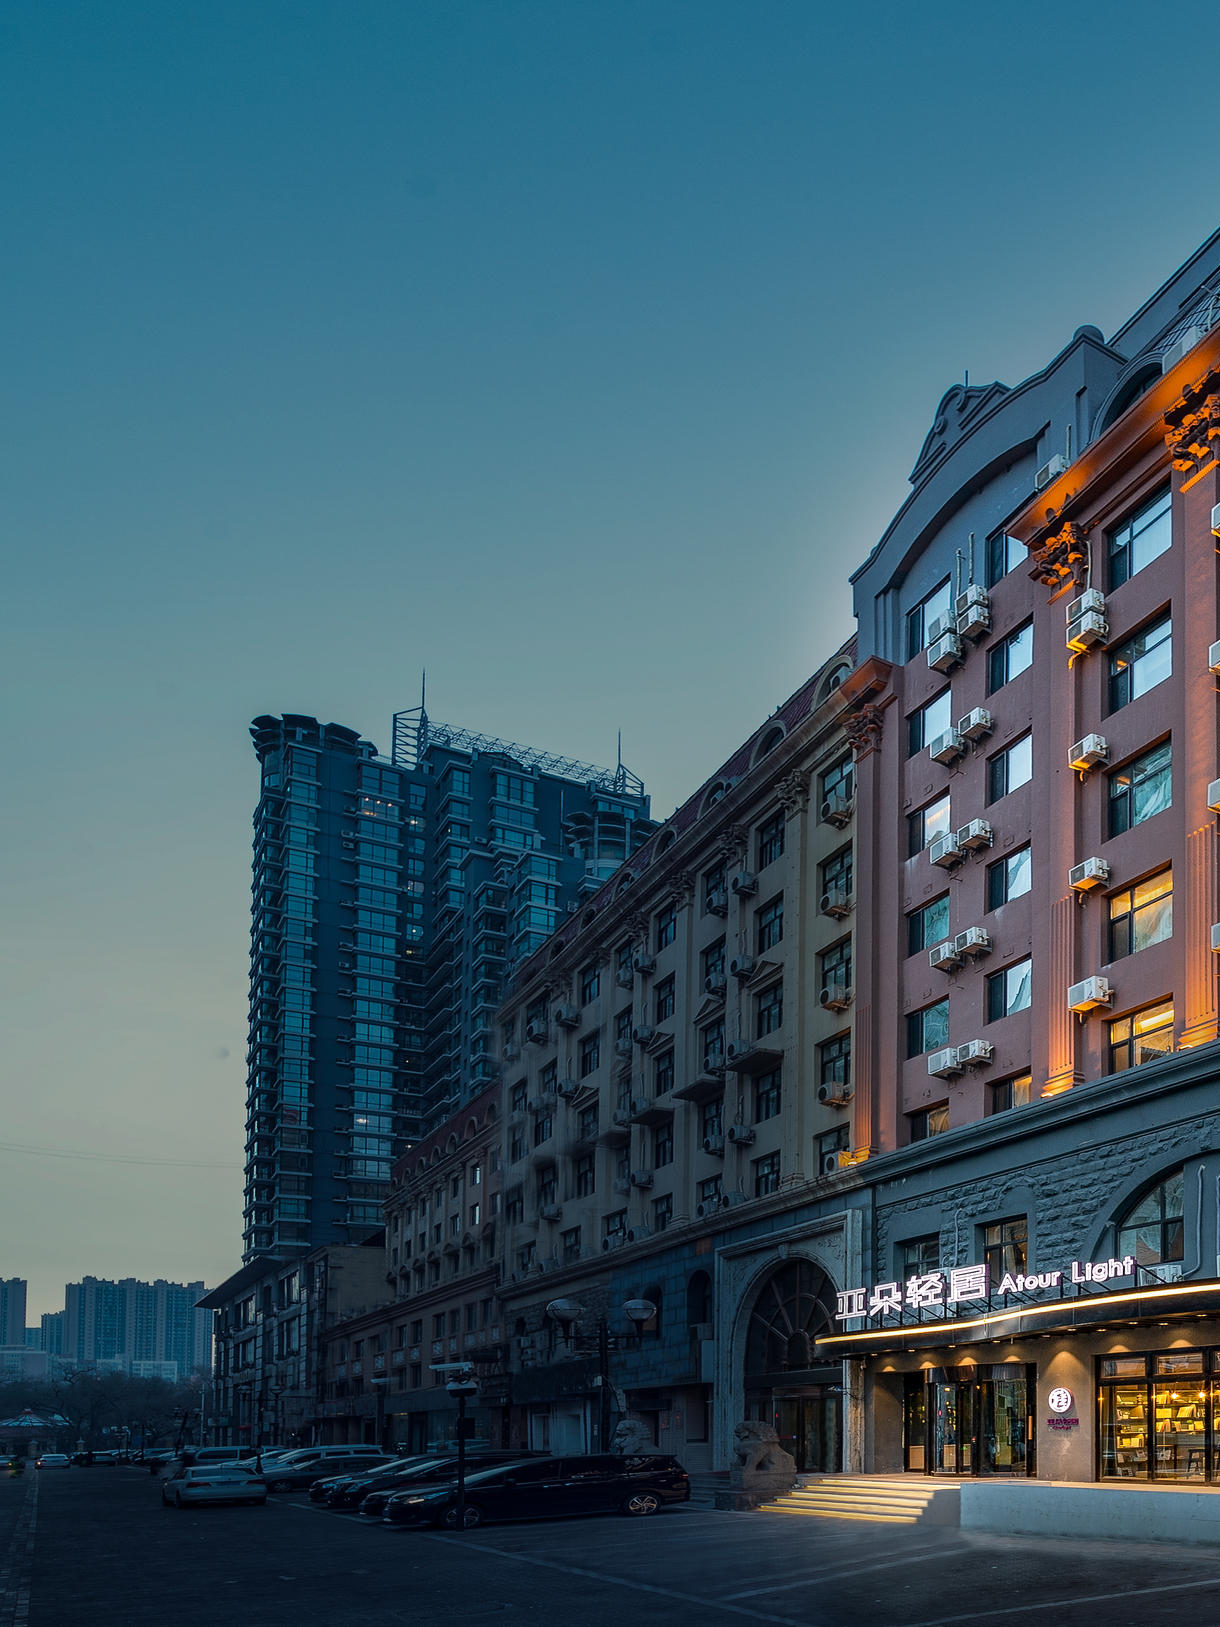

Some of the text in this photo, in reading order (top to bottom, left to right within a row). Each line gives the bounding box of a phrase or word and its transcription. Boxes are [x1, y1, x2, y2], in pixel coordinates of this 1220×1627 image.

[835, 1255, 1136, 1320] 亚朵轻居 Atour Light
